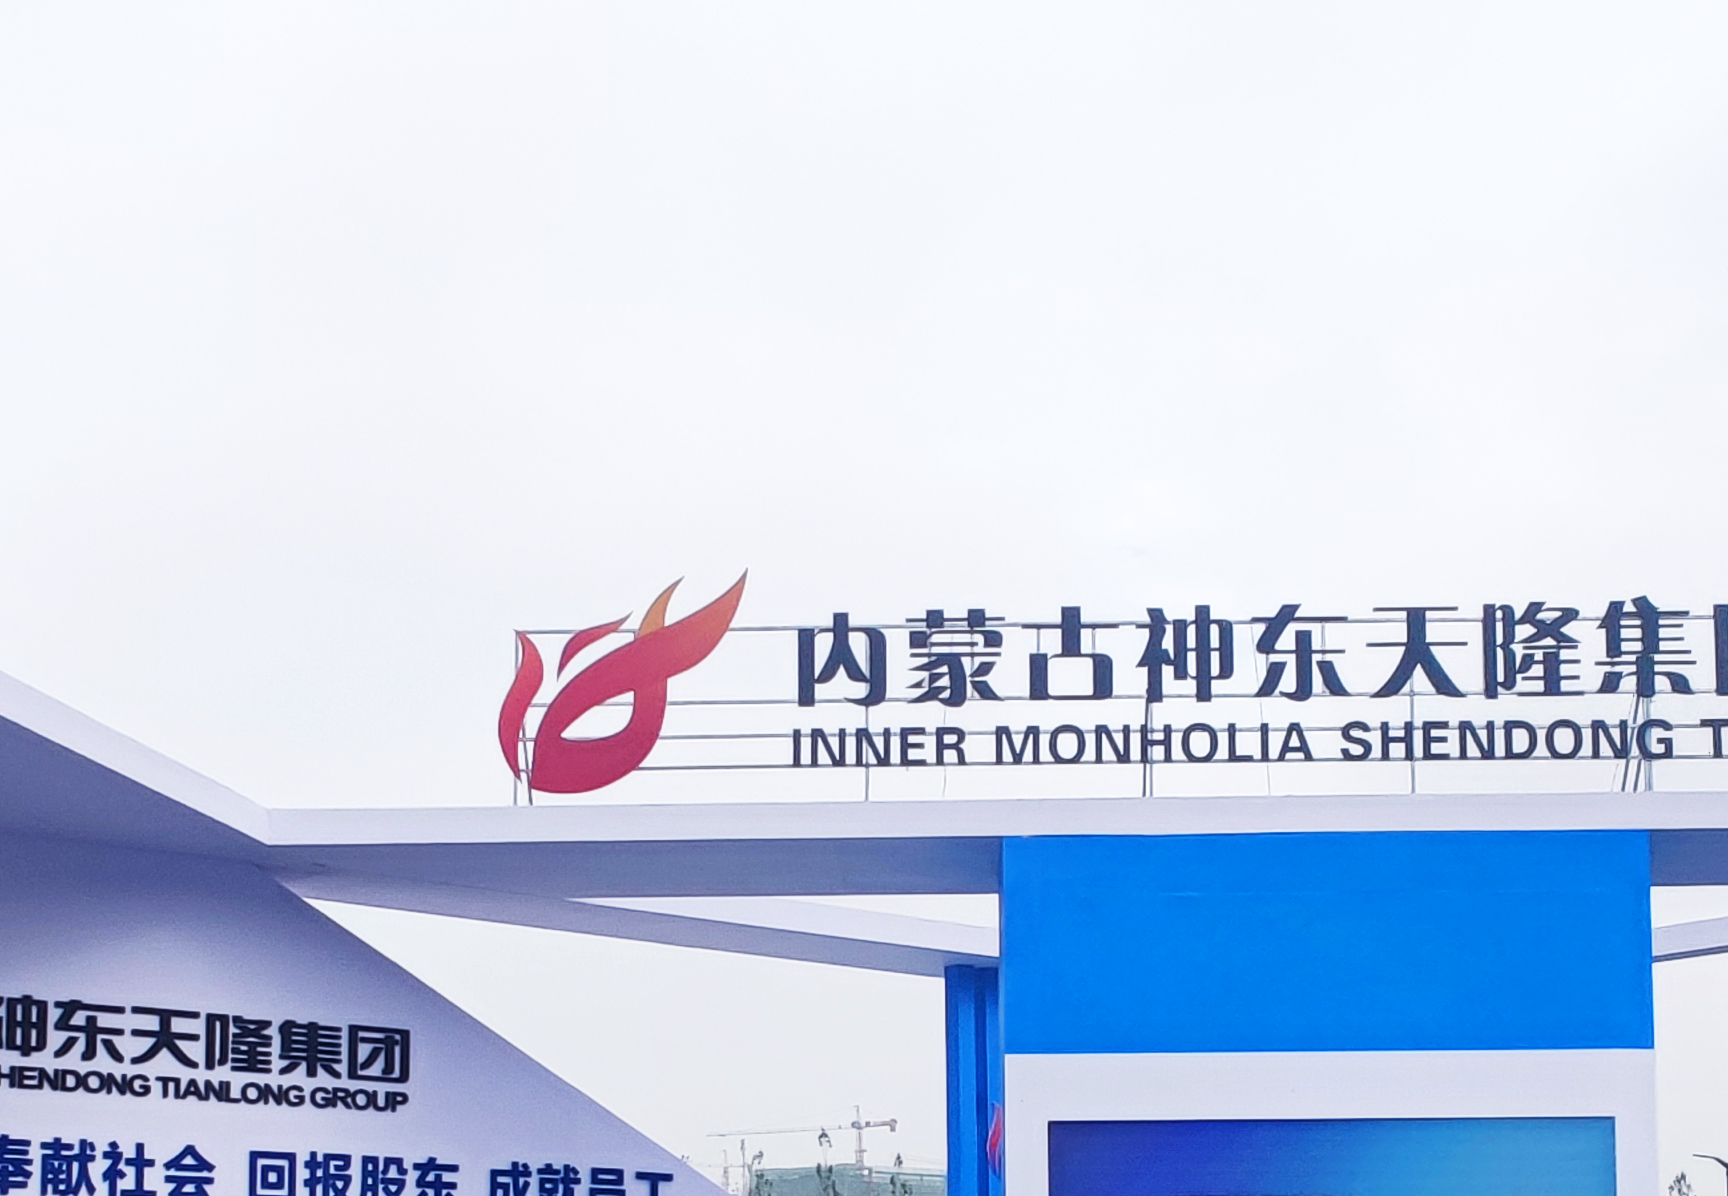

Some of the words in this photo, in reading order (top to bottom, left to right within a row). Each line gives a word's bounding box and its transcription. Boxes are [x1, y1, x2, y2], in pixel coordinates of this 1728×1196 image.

[792, 726, 967, 767] INNER
[995, 722, 1314, 764] MONHOLIA
[1340, 718, 1673, 761] SHENDONG
[155, 1077, 305, 1108] TIANLONG
[309, 1087, 409, 1113] GROUP
